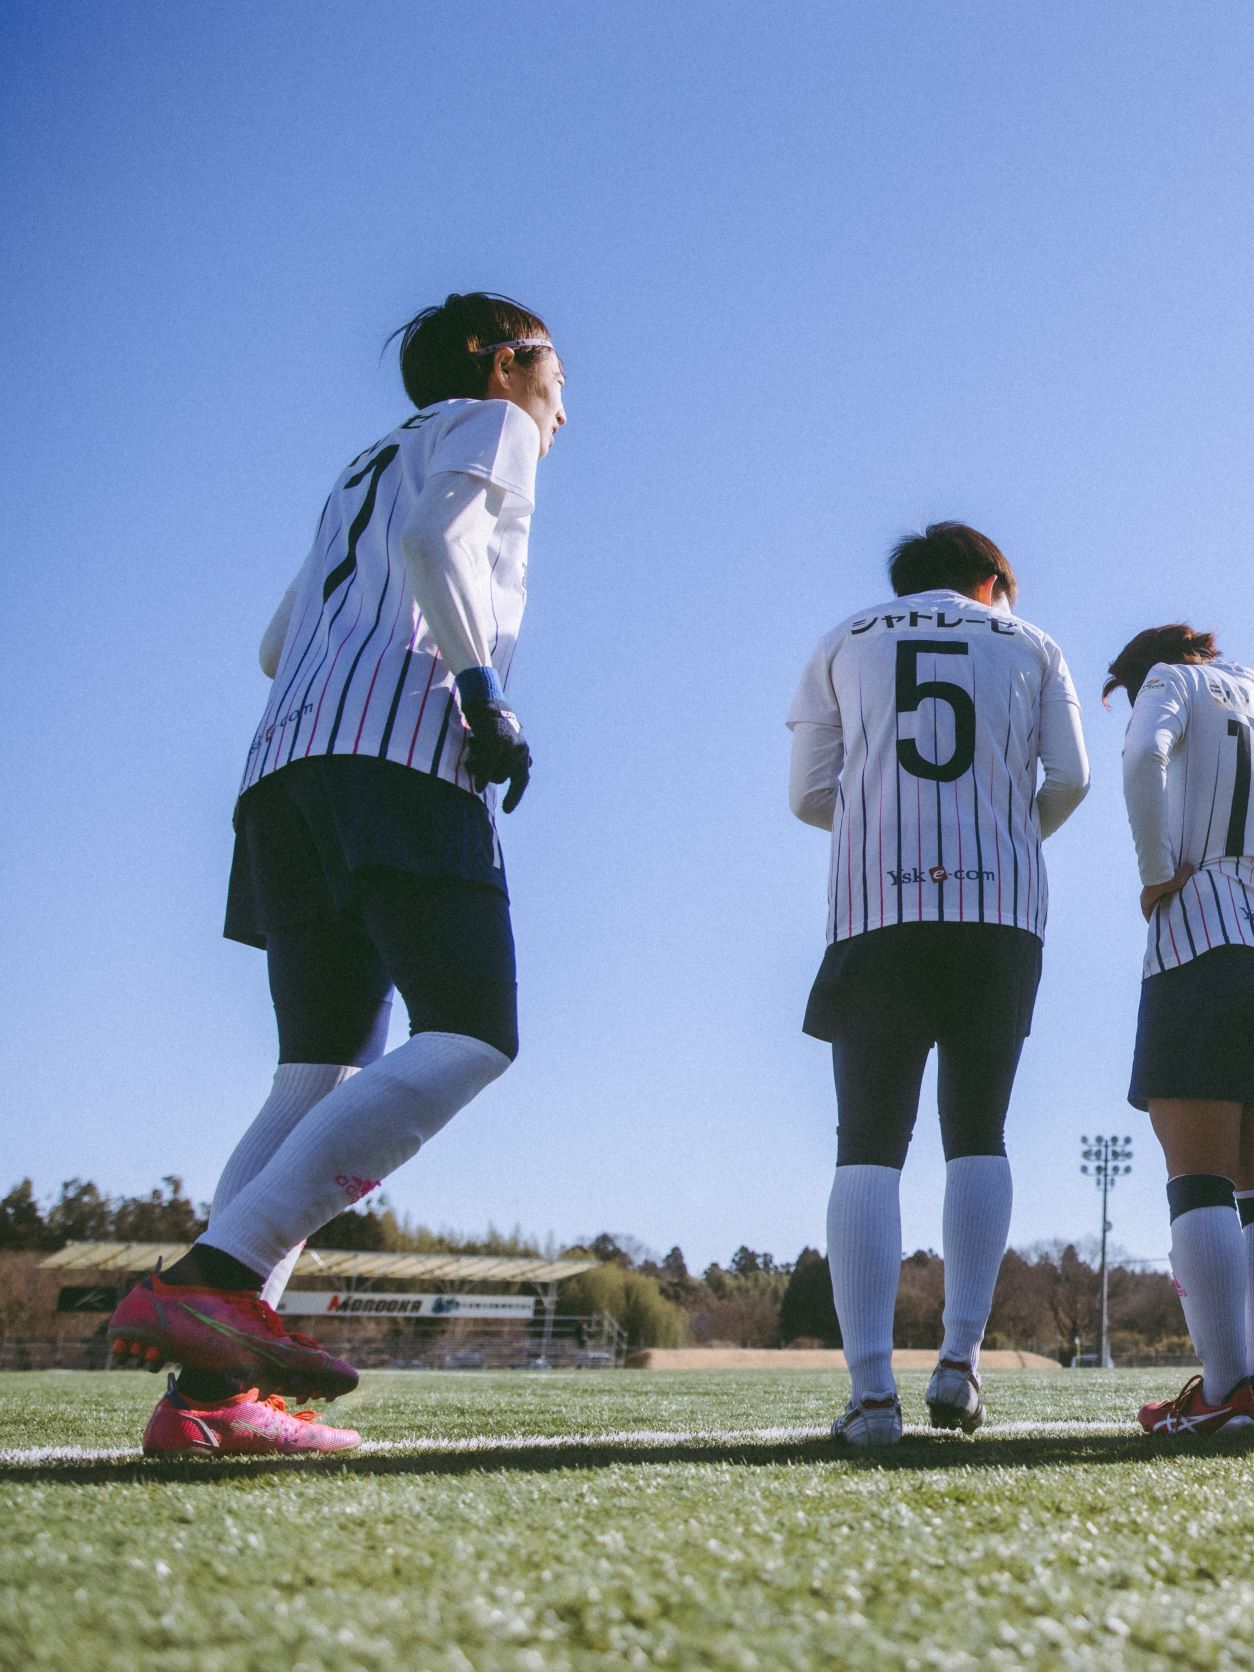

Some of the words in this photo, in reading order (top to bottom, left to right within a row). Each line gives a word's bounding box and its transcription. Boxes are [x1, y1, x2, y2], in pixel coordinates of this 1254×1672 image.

[323, 444, 401, 604] 7
[896, 640, 976, 783] 5
[887, 868, 926, 886] Ysk
